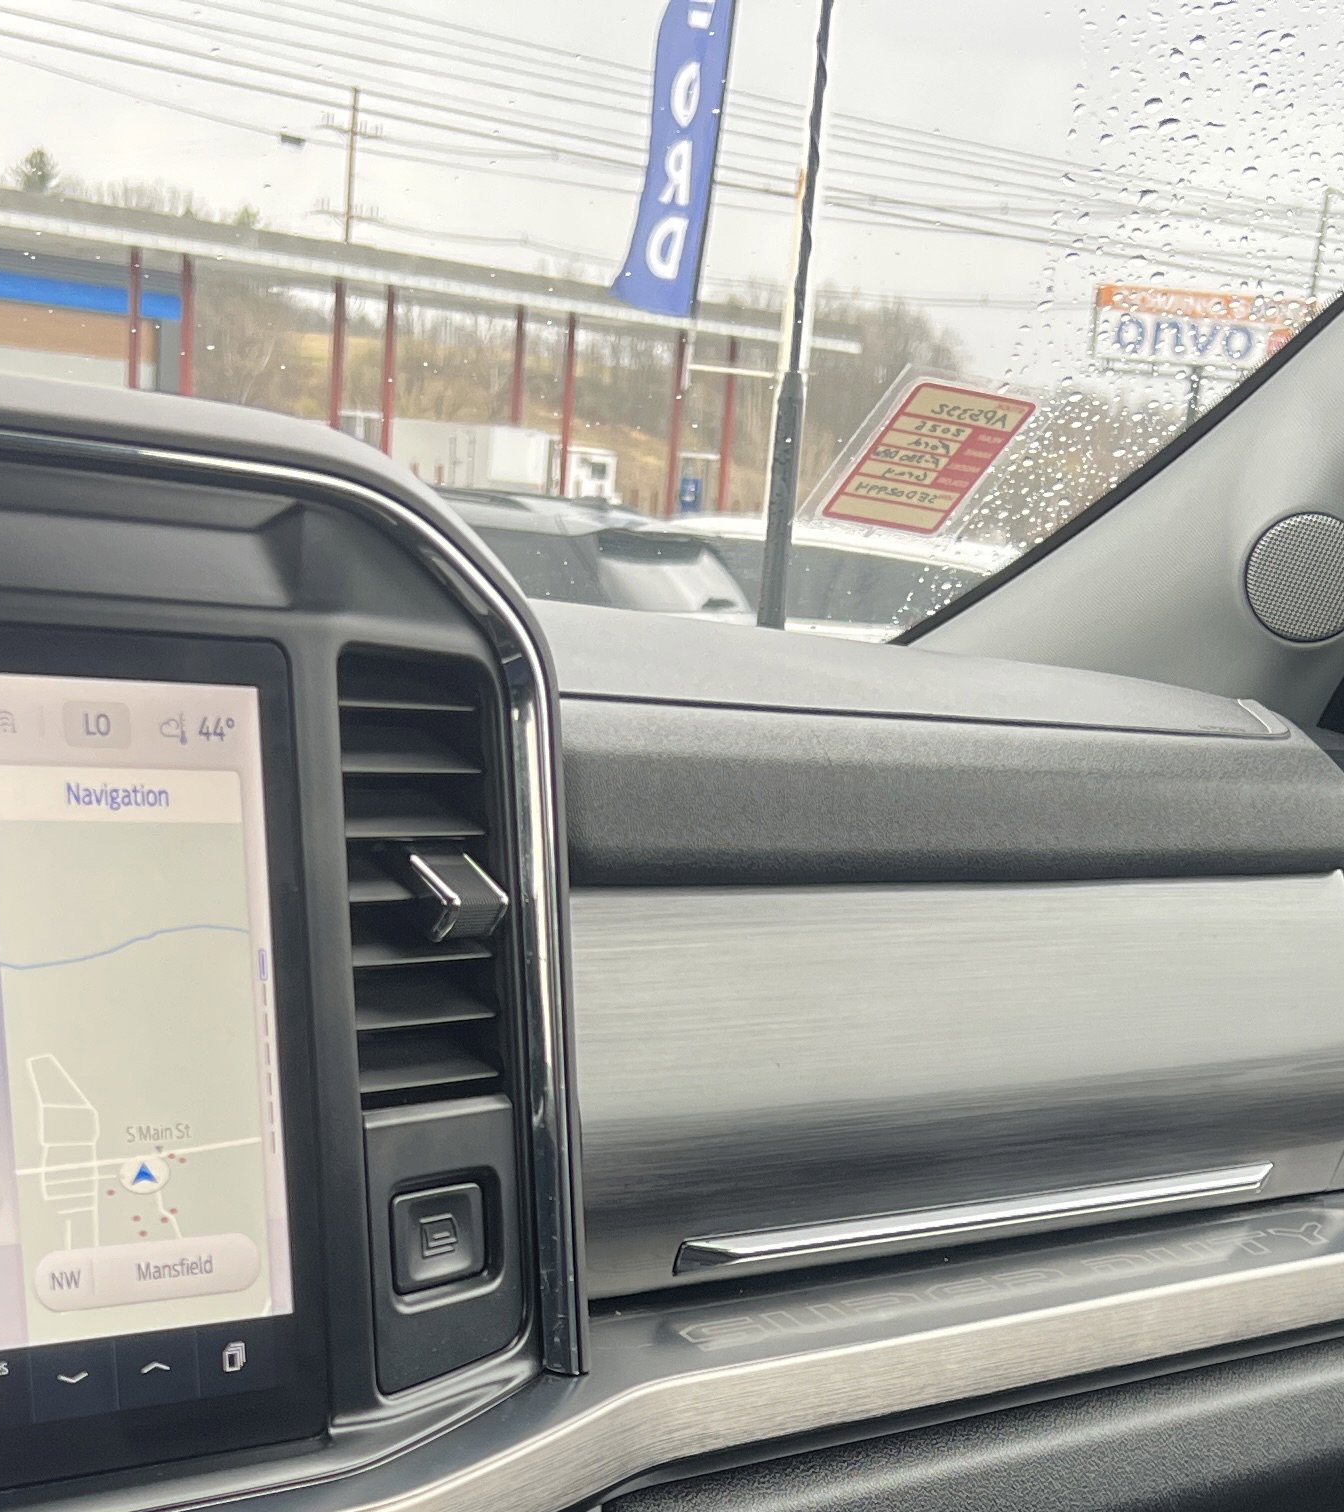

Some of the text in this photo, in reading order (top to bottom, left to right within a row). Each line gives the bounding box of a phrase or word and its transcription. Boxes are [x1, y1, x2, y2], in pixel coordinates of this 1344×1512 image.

[84, 712, 111, 738] LO
[197, 716, 235, 743] 44°
[66, 782, 170, 811] Navigation
[126, 1122, 191, 1141] S Main St
[50, 1268, 81, 1291] NW
[135, 1255, 214, 1282] Mansfield
